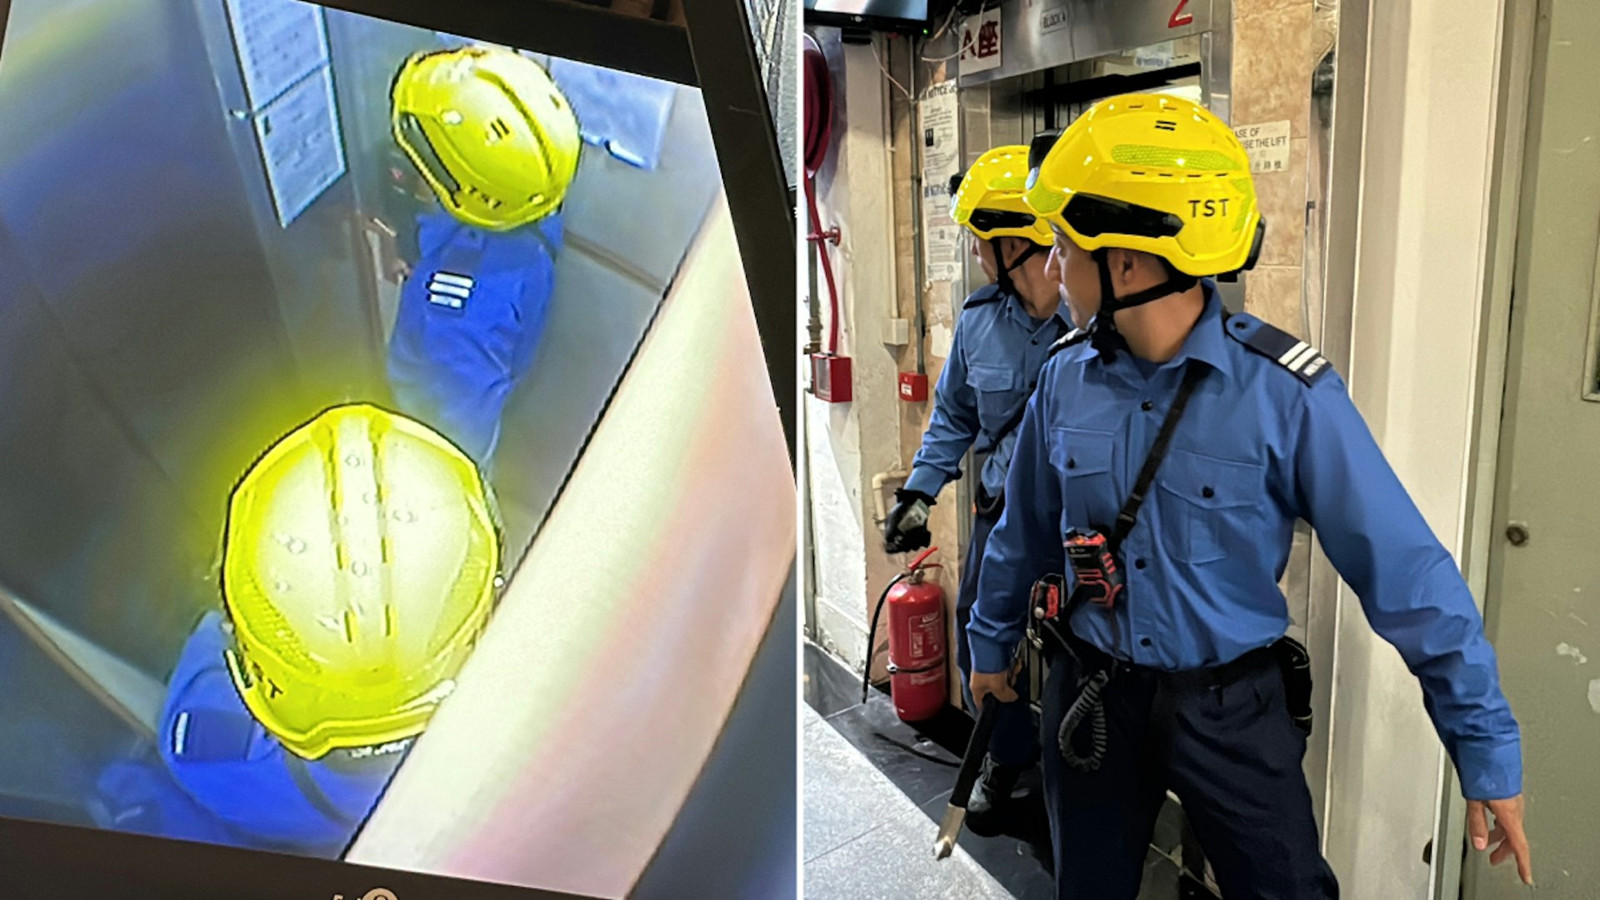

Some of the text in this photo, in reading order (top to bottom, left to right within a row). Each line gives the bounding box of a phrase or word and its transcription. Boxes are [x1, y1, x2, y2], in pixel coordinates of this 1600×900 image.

[1168, 0, 1193, 28] 2
[961, 21, 998, 60] A座
[1250, 127, 1260, 137] OF
[1256, 138, 1269, 148] THE
[1271, 136, 1287, 147] LIFT
[1188, 198, 1230, 218] TST
